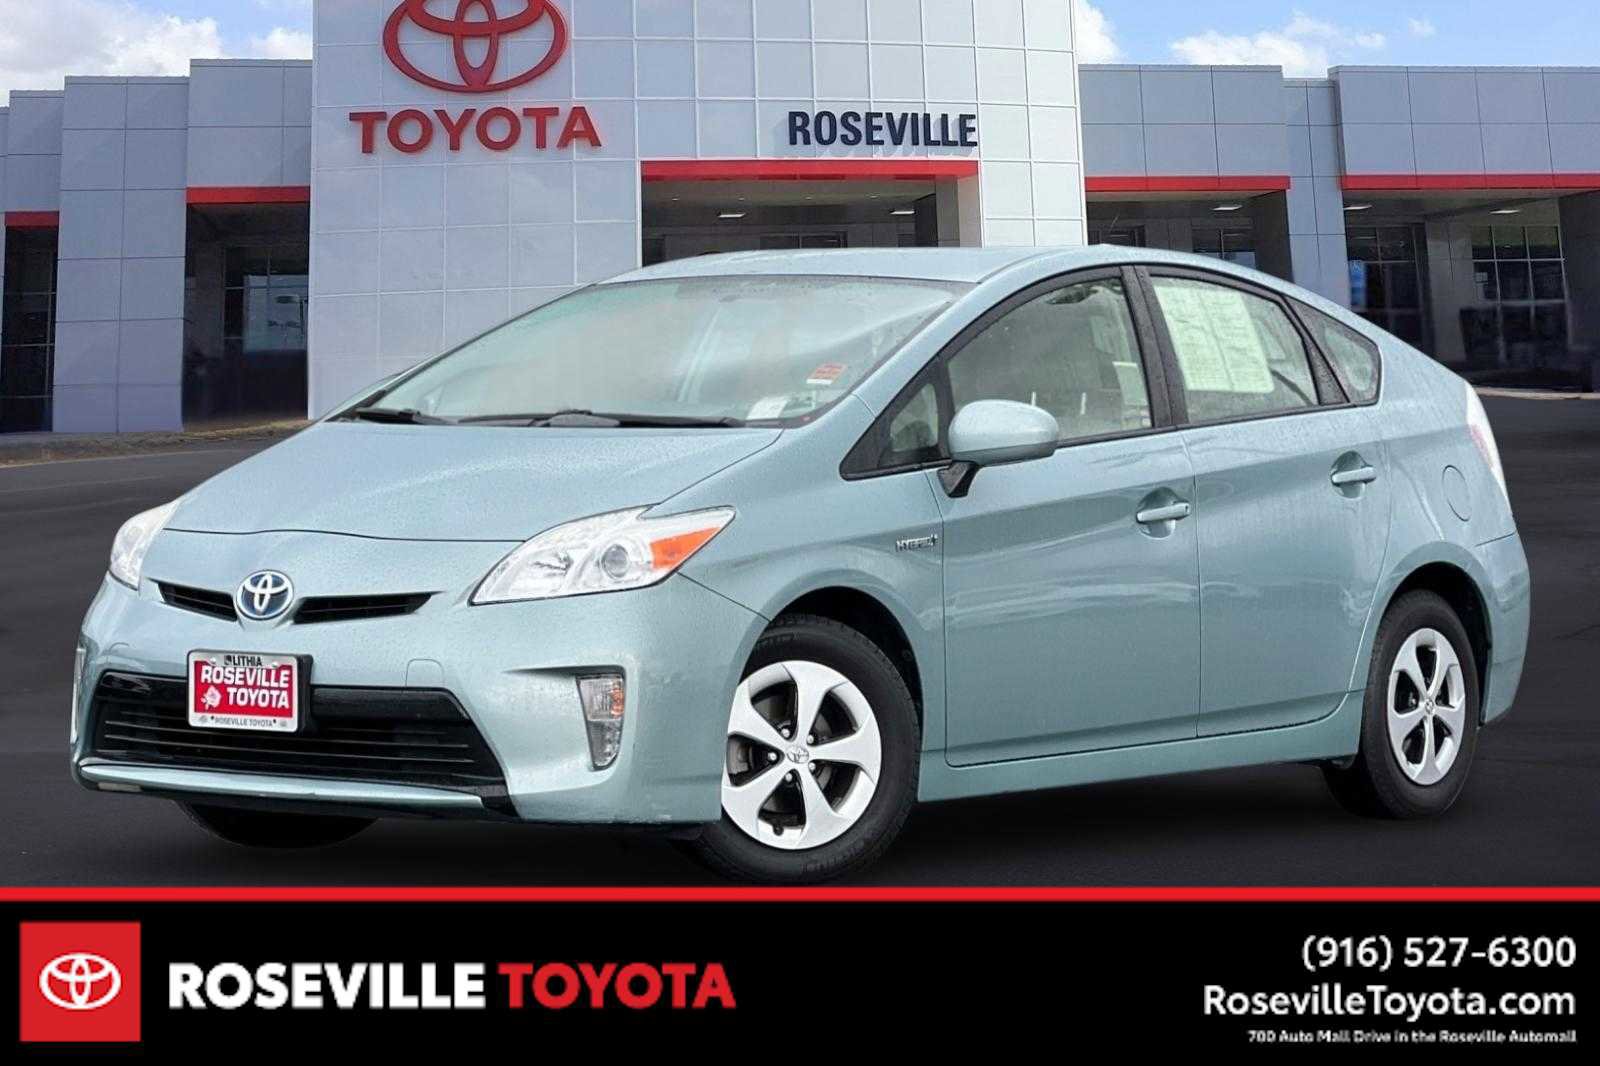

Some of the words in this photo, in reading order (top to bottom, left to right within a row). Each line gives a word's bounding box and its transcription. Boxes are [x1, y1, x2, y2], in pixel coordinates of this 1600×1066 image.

[349, 106, 602, 153] TOYOTA
[789, 111, 978, 147] ROSEVILLE
[233, 655, 263, 667] LITHIA
[200, 665, 290, 688] ROSEVILLE
[226, 687, 290, 709] TOYOTA
[214, 716, 248, 727] ROSEVILLE
[249, 718, 273, 728] TOYOTA
